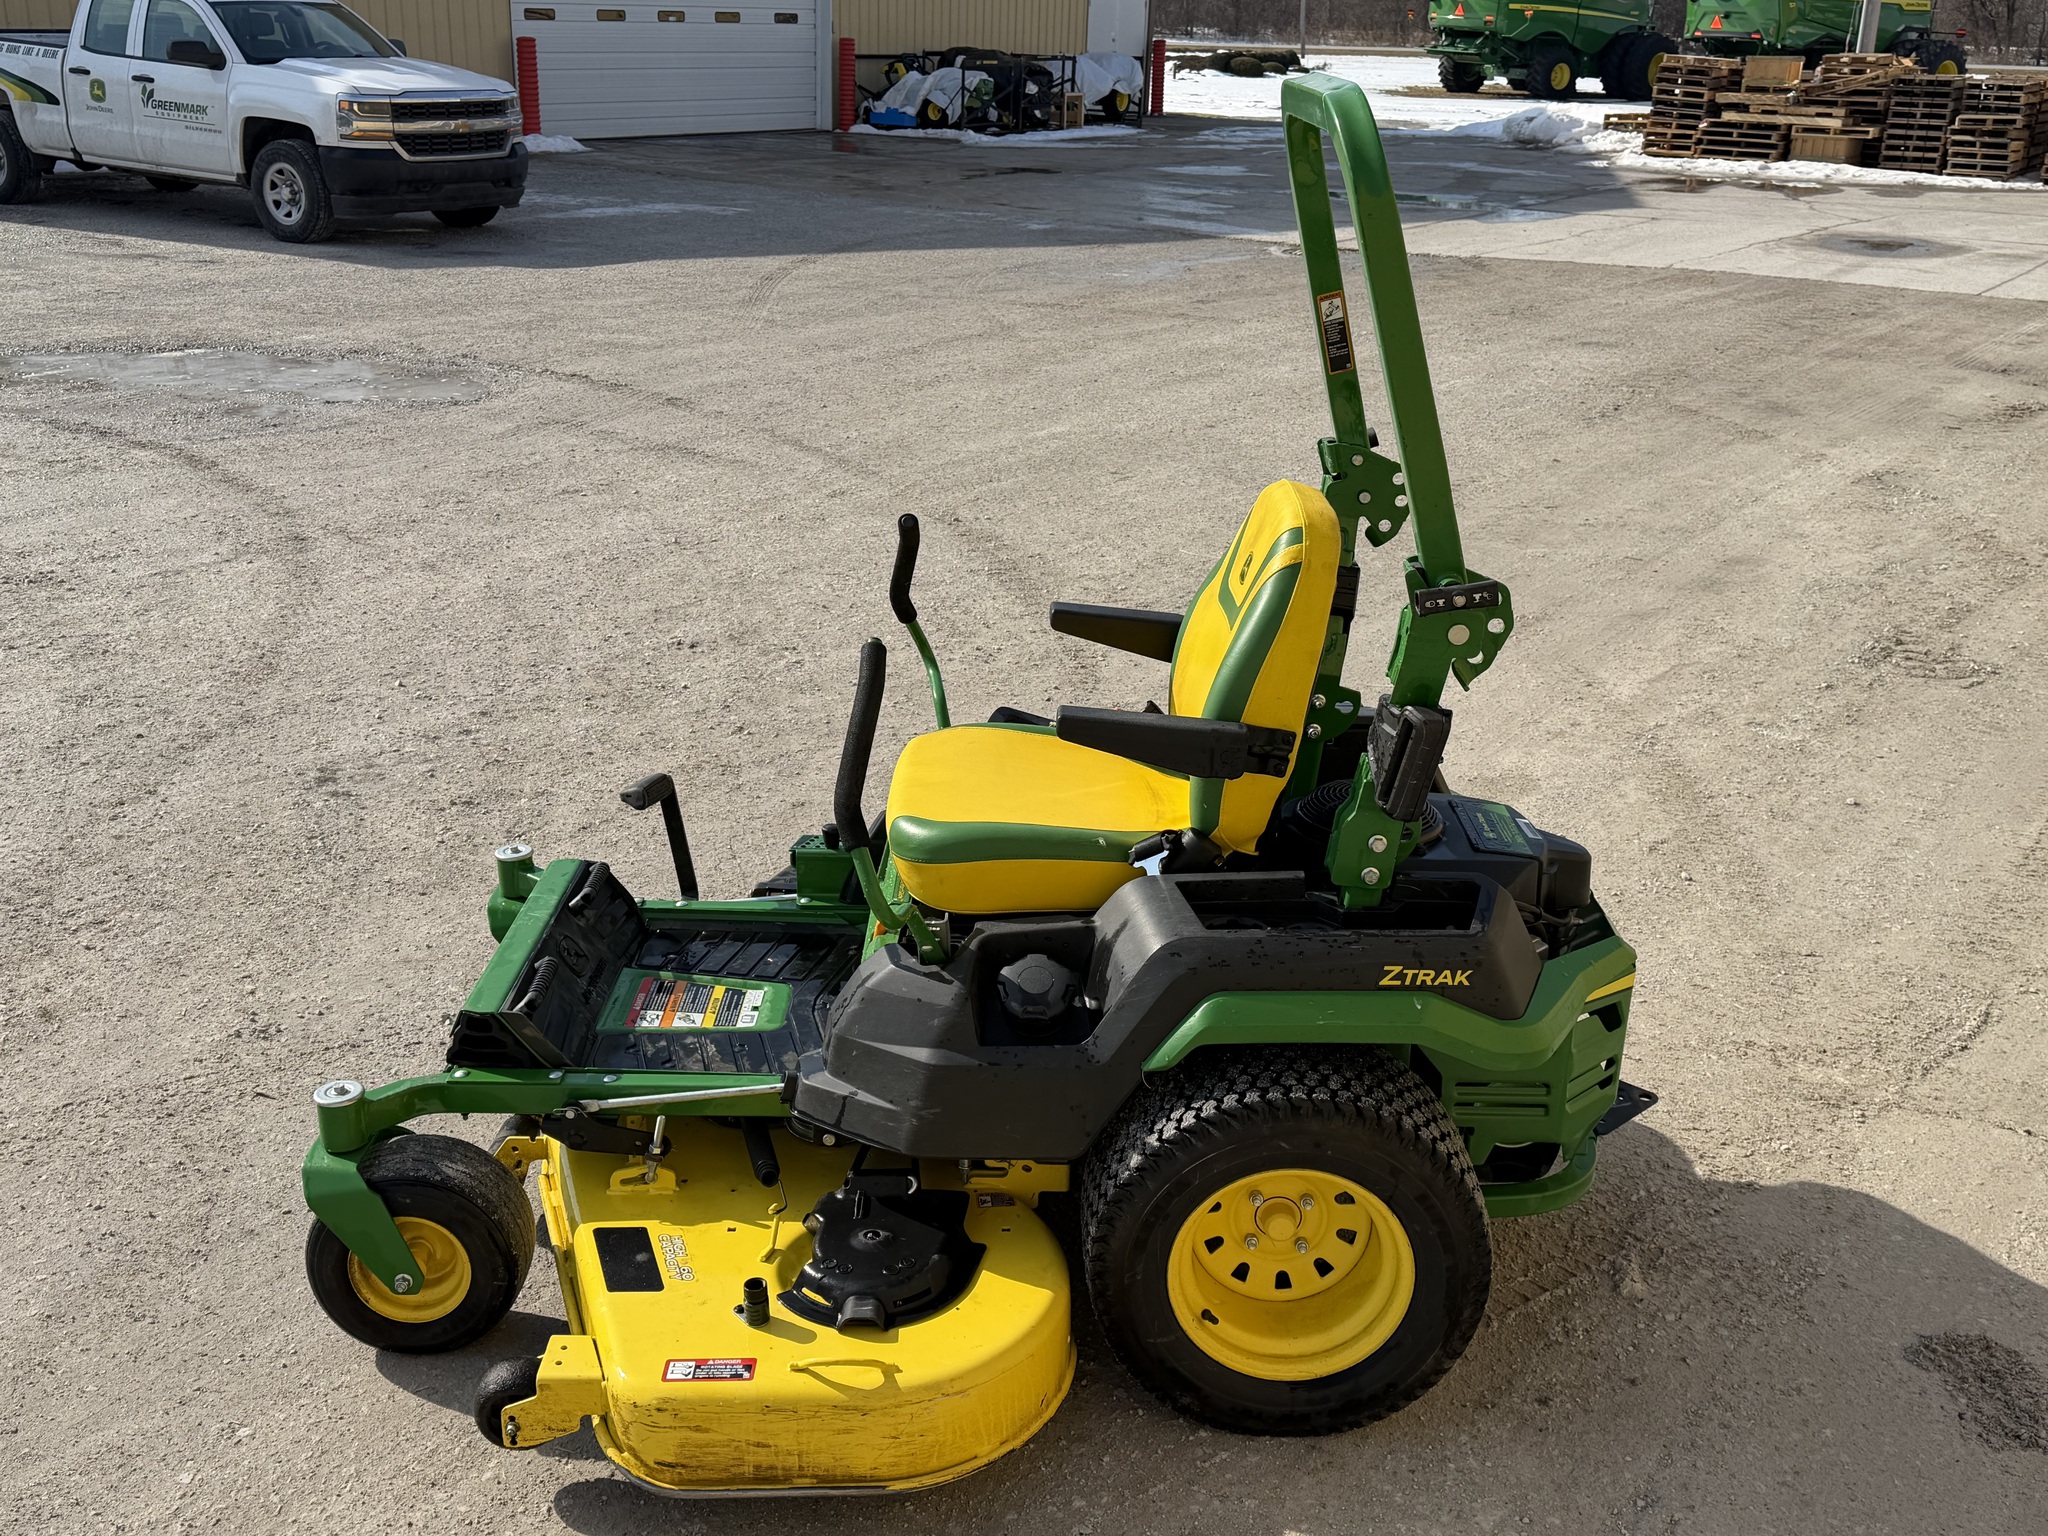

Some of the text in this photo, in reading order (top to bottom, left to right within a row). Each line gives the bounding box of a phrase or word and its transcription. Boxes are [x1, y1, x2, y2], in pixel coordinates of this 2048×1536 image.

[22, 46, 35, 56] LIKE
[35, 48, 41, 57] A
[42, 49, 60, 59] DEERE
[150, 100, 208, 116] GREENMARK
[155, 111, 205, 121] EQUIPMENT
[1378, 966, 1474, 986] ZTRAK
[658, 1234, 682, 1281] CAPACITY
[670, 1235, 694, 1281] HIGH 60
